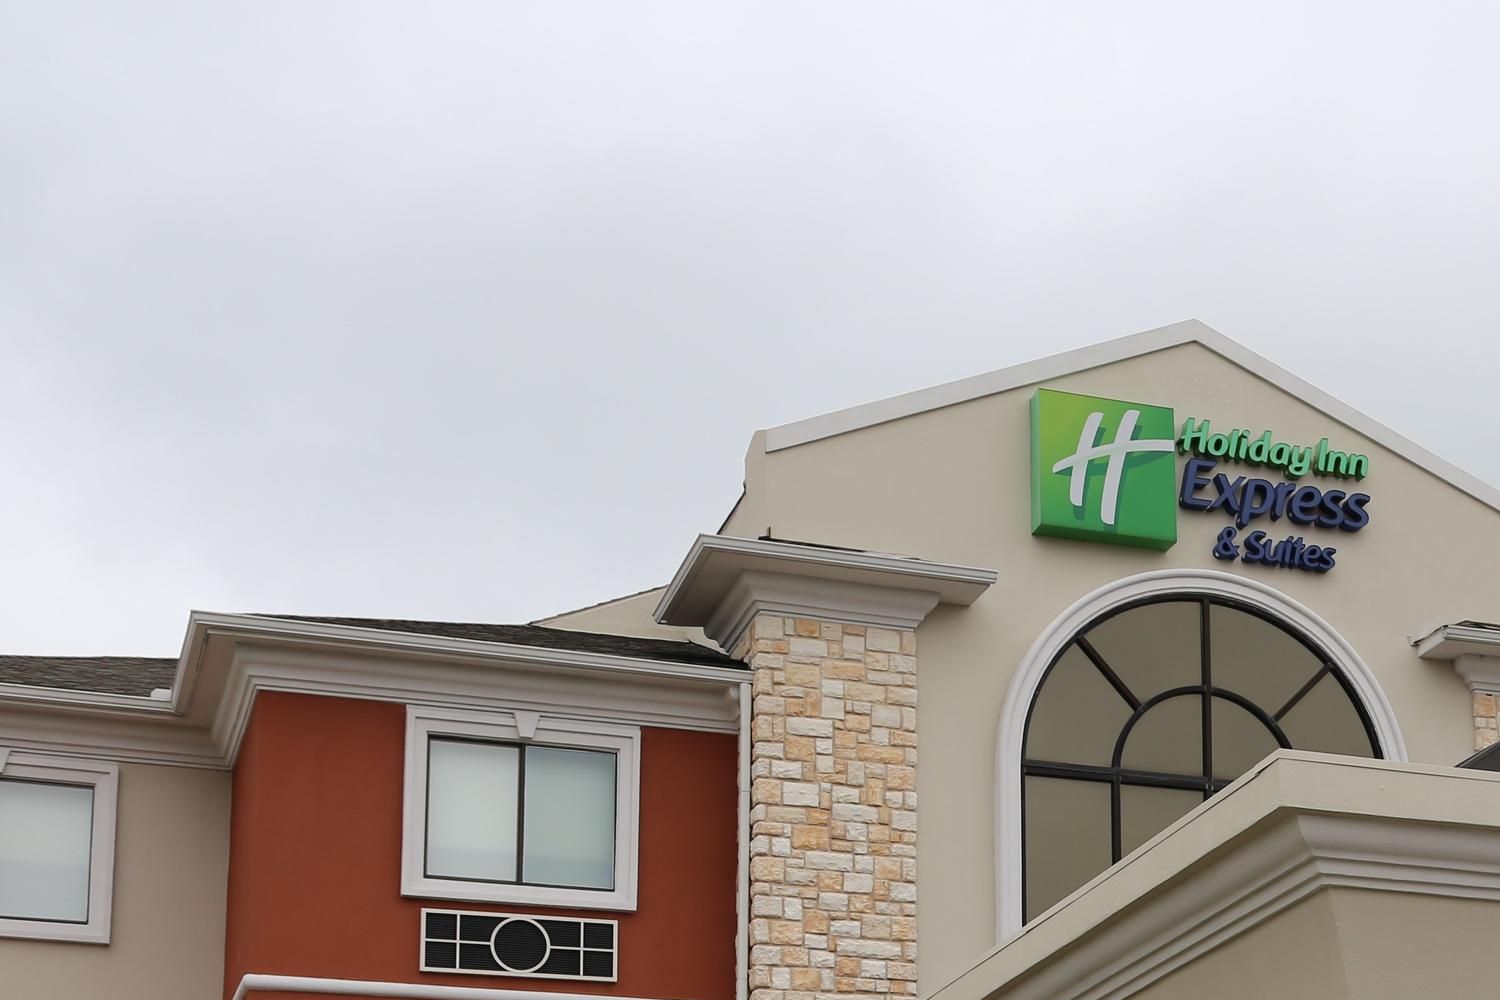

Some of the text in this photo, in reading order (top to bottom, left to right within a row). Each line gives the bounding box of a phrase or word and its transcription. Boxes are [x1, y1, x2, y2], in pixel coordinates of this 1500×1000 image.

[1052, 409, 1175, 525] H
[1179, 417, 1369, 480] Holiday Inn
[1179, 457, 1371, 532] Express
[1212, 526, 1336, 572] & Suites
